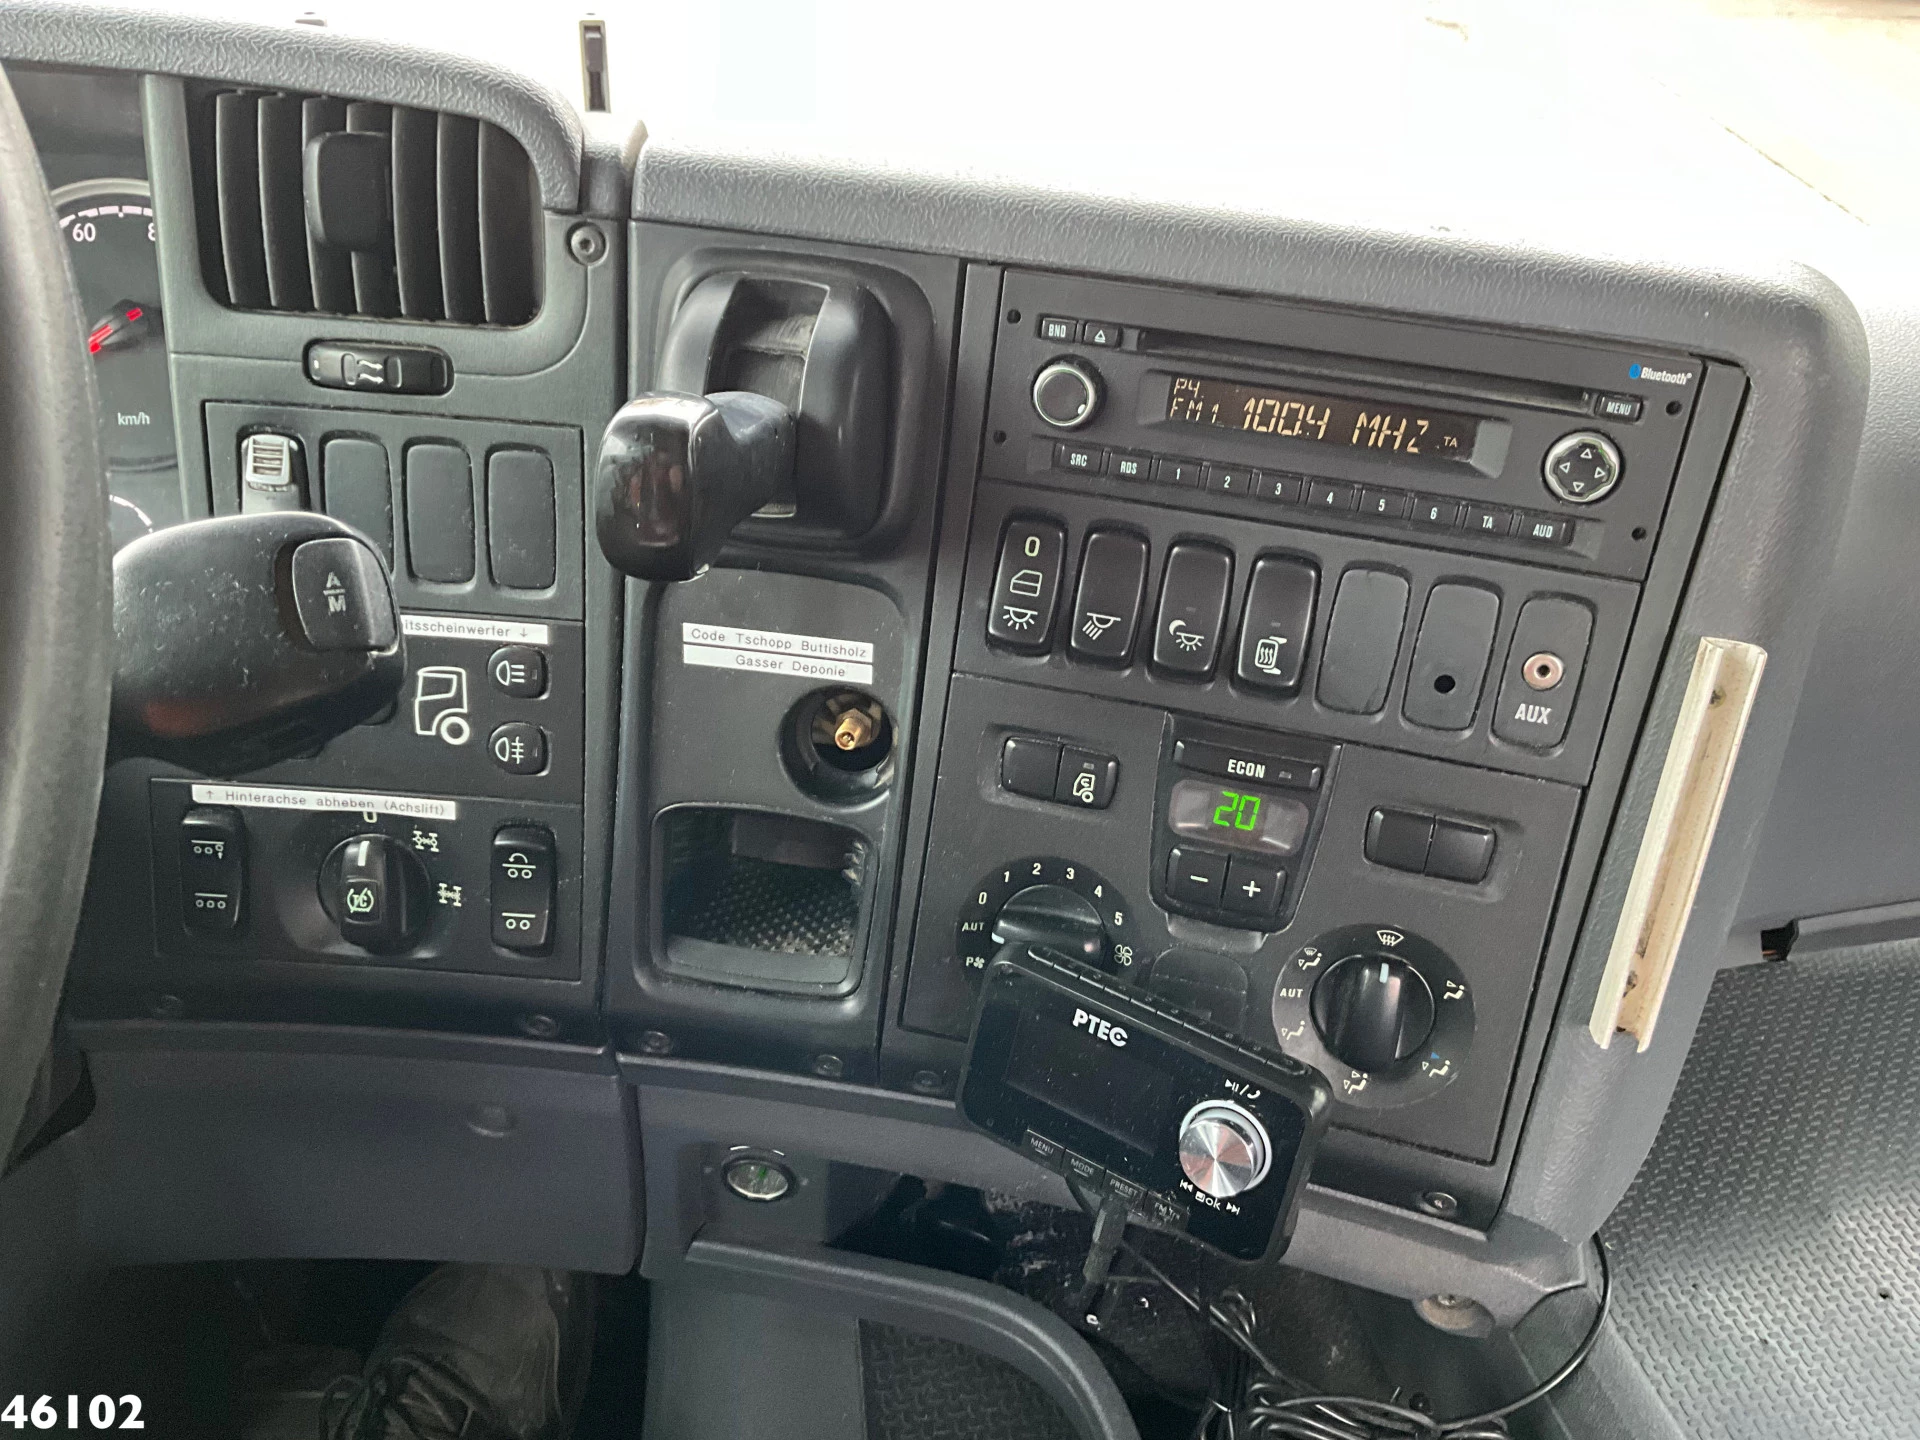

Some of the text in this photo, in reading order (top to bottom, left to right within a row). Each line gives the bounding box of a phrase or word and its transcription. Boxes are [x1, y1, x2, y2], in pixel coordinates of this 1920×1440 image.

[72, 222, 97, 242] 60
[147, 222, 157, 242] 8
[1048, 324, 1067, 338] BND
[1605, 401, 1632, 416] MENU
[117, 411, 151, 427] km/h
[1443, 435, 1459, 448] TA
[1070, 453, 1088, 467] SRC
[1119, 461, 1138, 475] RDS
[1175, 468, 1181, 481] 1
[1223, 475, 1231, 489] 2
[1274, 482, 1282, 496] 3
[1326, 491, 1334, 505] 4
[1377, 498, 1386, 512] 5
[1429, 506, 1438, 520] 6
[1482, 515, 1493, 529] TA
[1532, 523, 1554, 539] AUD
[326, 571, 342, 588] A
[327, 594, 347, 614] M
[404, 619, 511, 638] itsscheinwerfer
[691, 628, 868, 659] Code Tschopp Buttisholz
[735, 654, 847, 678] Gasser Deponie
[1514, 702, 1553, 726] AUX
[1227, 758, 1267, 779] ECON
[225, 789, 446, 816] Hinterachse abheben (Achslift)
[1212, 790, 1262, 831] 20
[1003, 870, 1011, 883] 1
[1032, 862, 1042, 877] 2
[1066, 867, 1076, 881] 3
[978, 891, 988, 906] 0
[1094, 884, 1103, 898] 4
[1114, 910, 1124, 926] 5
[961, 920, 985, 932] AUT
[1279, 987, 1304, 999] AUT
[1072, 1008, 1129, 1047] PTEC
[1030, 1136, 1055, 1155] MENU
[1070, 1157, 1095, 1176] MODE
[1109, 1177, 1140, 1197] PRESET
